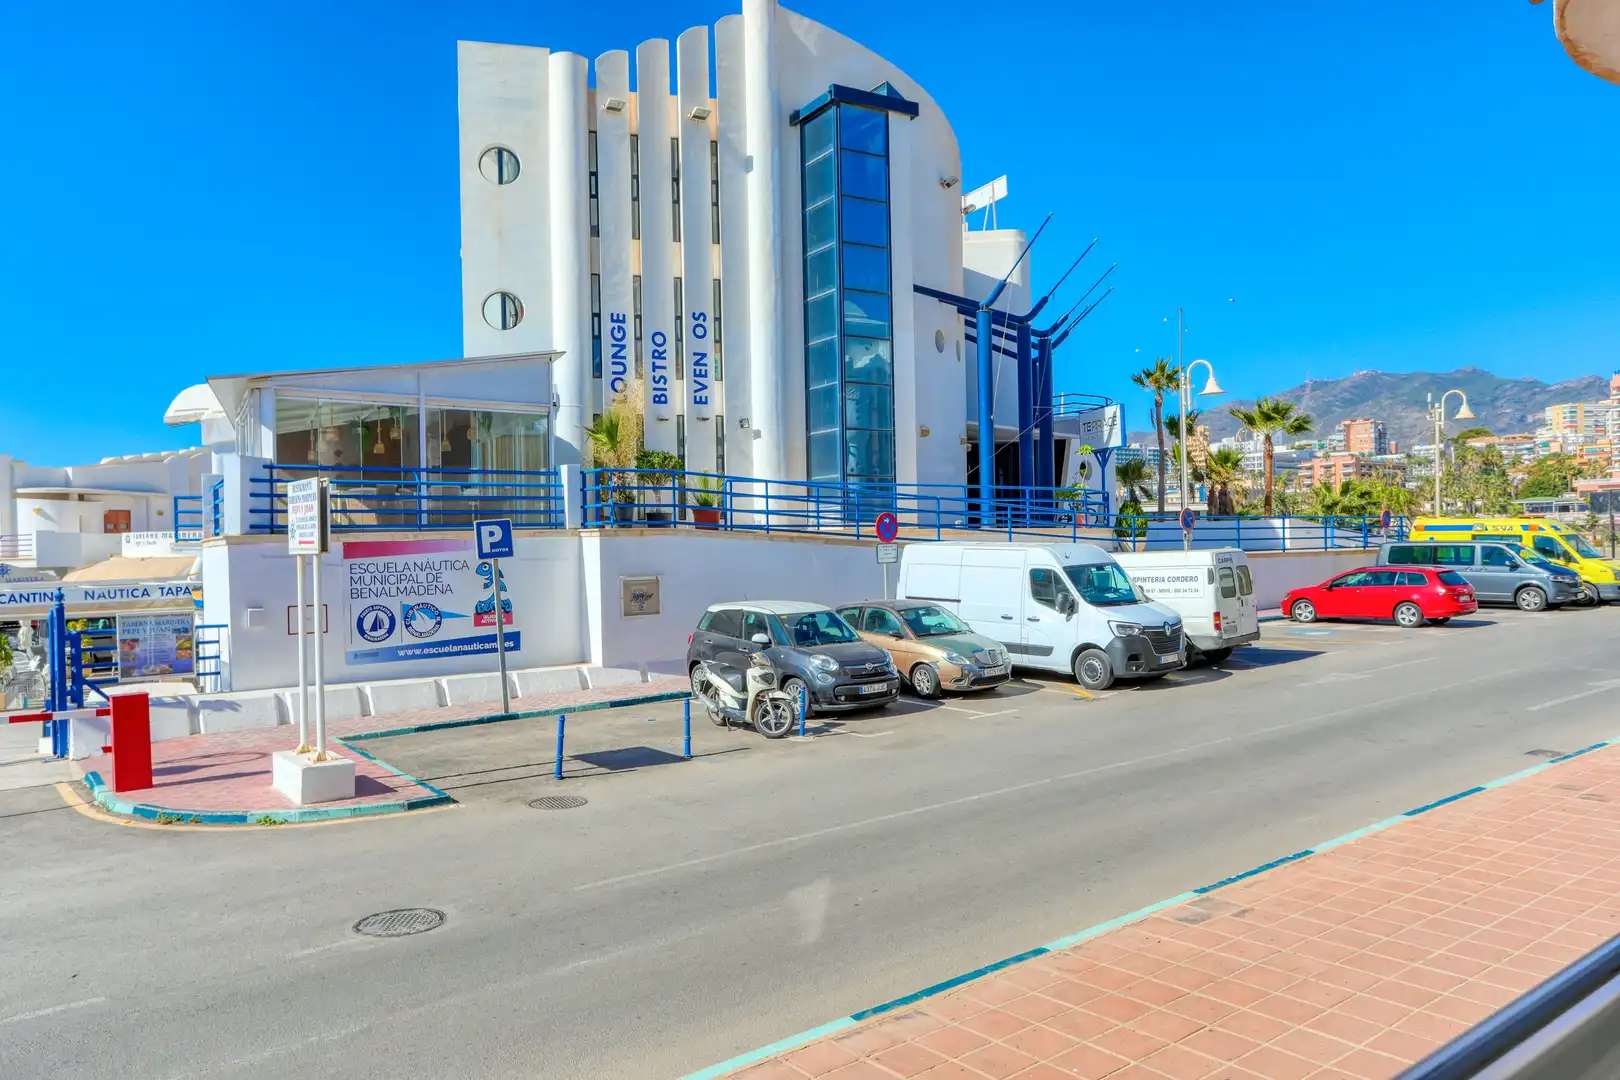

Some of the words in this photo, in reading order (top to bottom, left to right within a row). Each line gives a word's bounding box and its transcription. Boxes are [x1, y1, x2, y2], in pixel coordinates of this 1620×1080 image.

[610, 312, 627, 404] OUNGE
[651, 331, 667, 404] BISTRO
[162, 531, 203, 539] MAINERA
[480, 525, 503, 553] P
[349, 561, 411, 575] ESCUELA
[413, 558, 470, 572] NÁUTICA
[349, 573, 424, 587] MUNICIPAL
[425, 572, 444, 584] DE
[1167, 575, 1199, 583] CORDERO
[0, 591, 54, 605] CANTIN
[84, 588, 151, 600] NAUTICA
[159, 585, 192, 597] TAPA
[350, 583, 454, 600] BENALMÁDENA
[405, 608, 415, 625] CLUB
[397, 640, 515, 657] www.escuelanauticames
